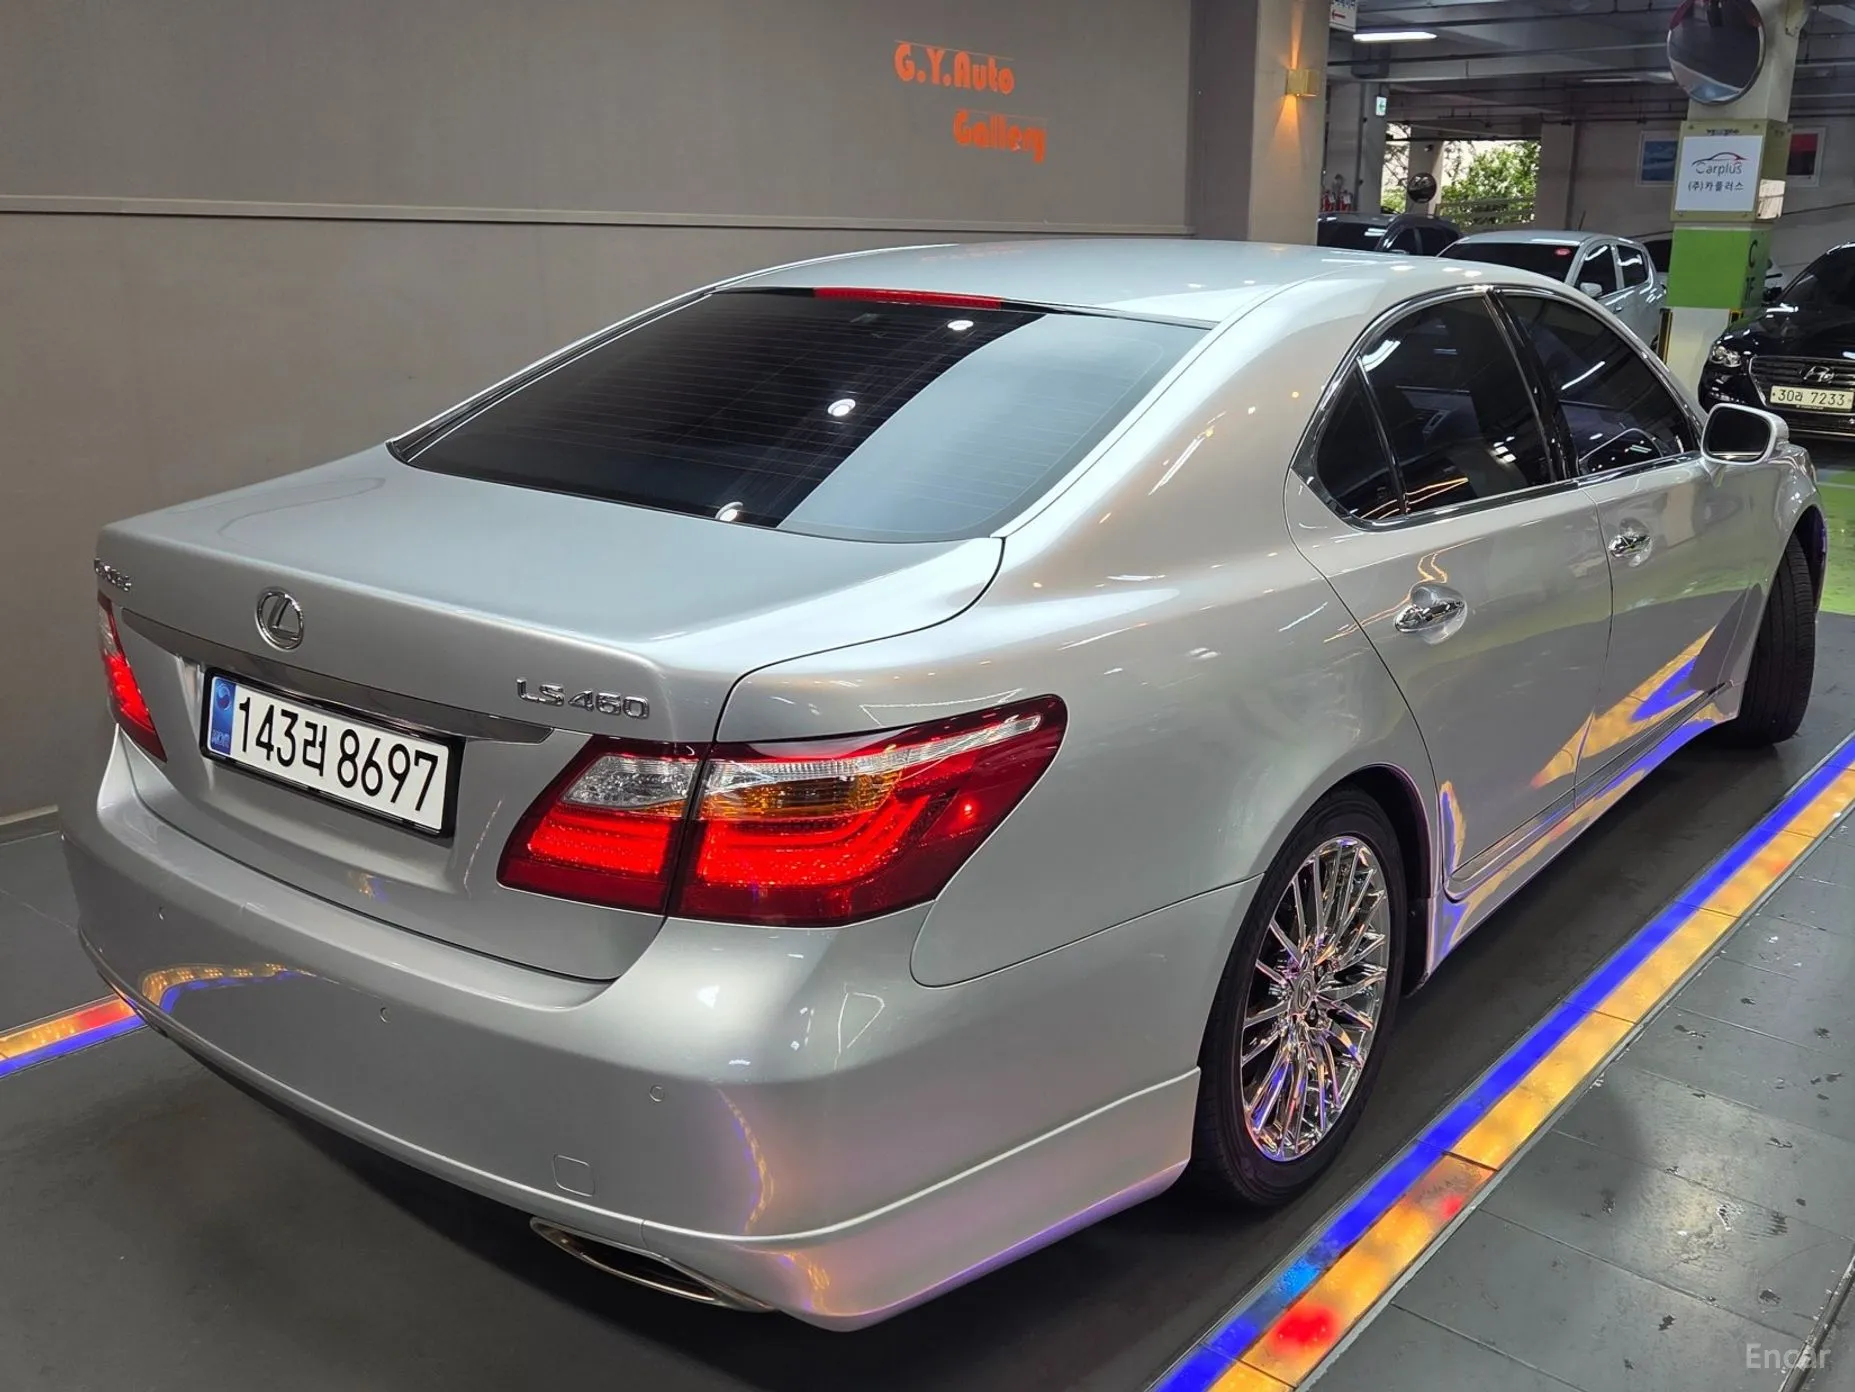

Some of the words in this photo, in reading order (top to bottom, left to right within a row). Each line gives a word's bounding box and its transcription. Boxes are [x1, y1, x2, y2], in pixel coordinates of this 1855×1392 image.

[894, 42, 1015, 95] G.Y.Auto
[953, 108, 1047, 164] Gallery
[1695, 161, 1743, 177] Carplus
[1811, 391, 1845, 406] 7233
[238, 696, 328, 778] 143러
[336, 728, 439, 812] 8697
